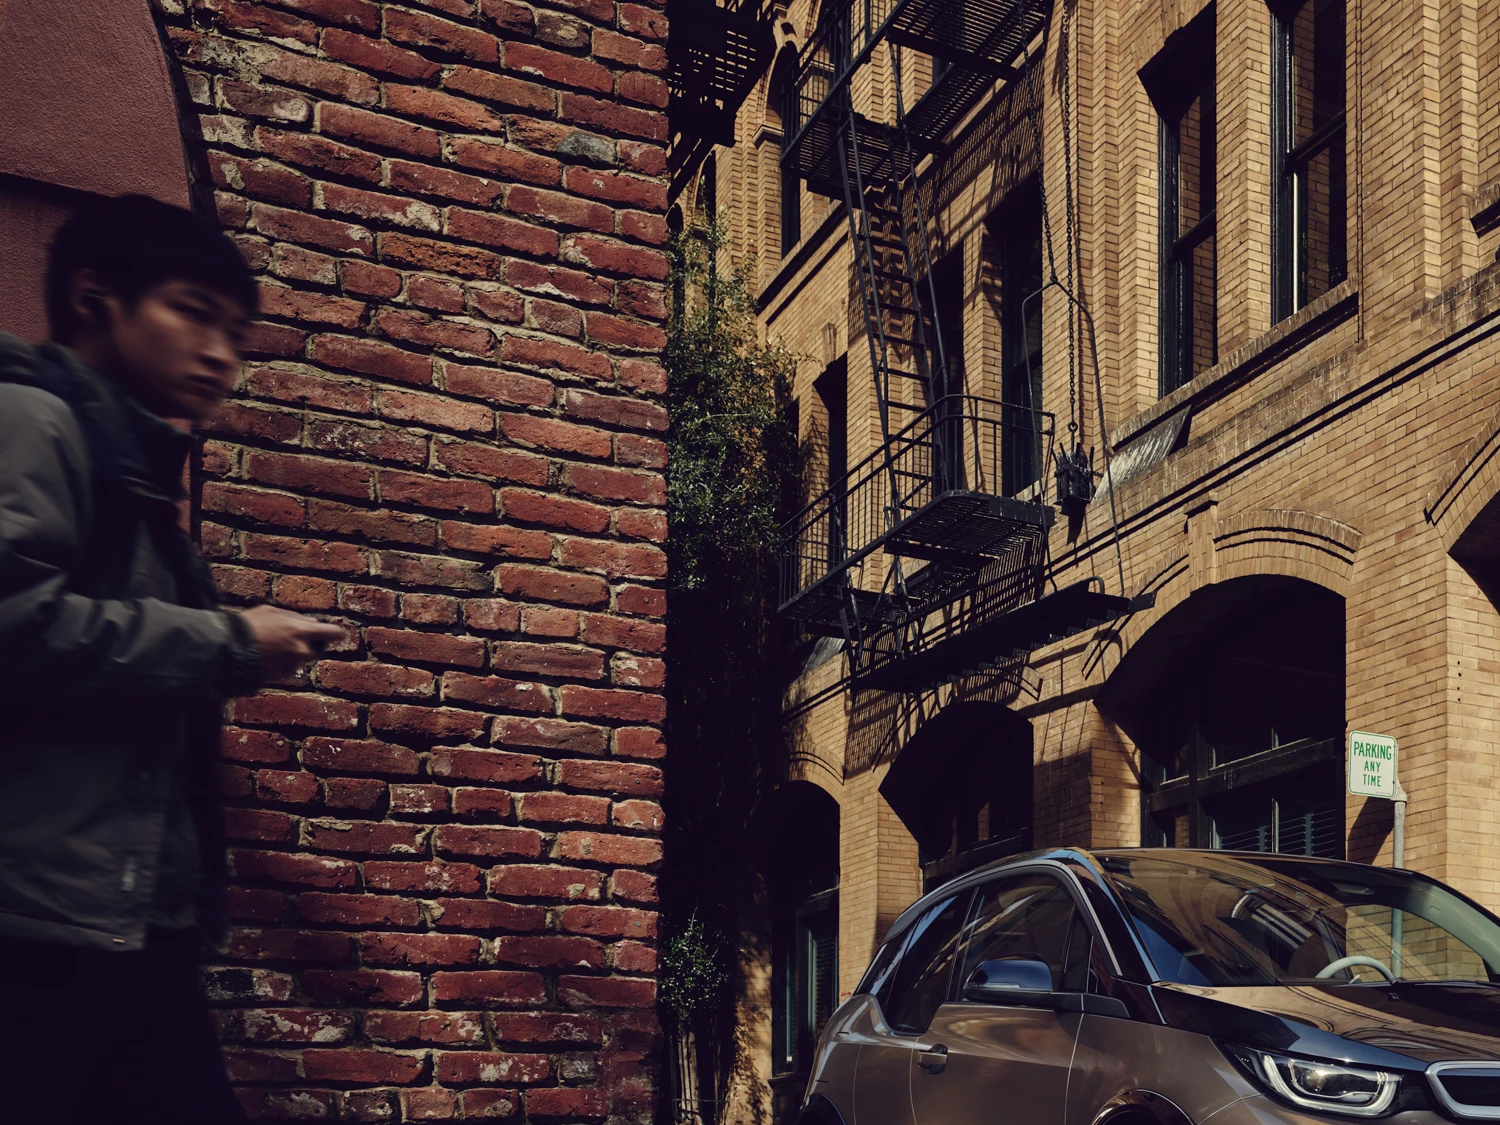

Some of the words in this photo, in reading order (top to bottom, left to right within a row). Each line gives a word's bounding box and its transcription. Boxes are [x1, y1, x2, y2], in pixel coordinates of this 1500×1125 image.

[1353, 741, 1392, 760] PARKING
[1363, 760, 1381, 773] ANY
[1363, 773, 1382, 788] TIME
